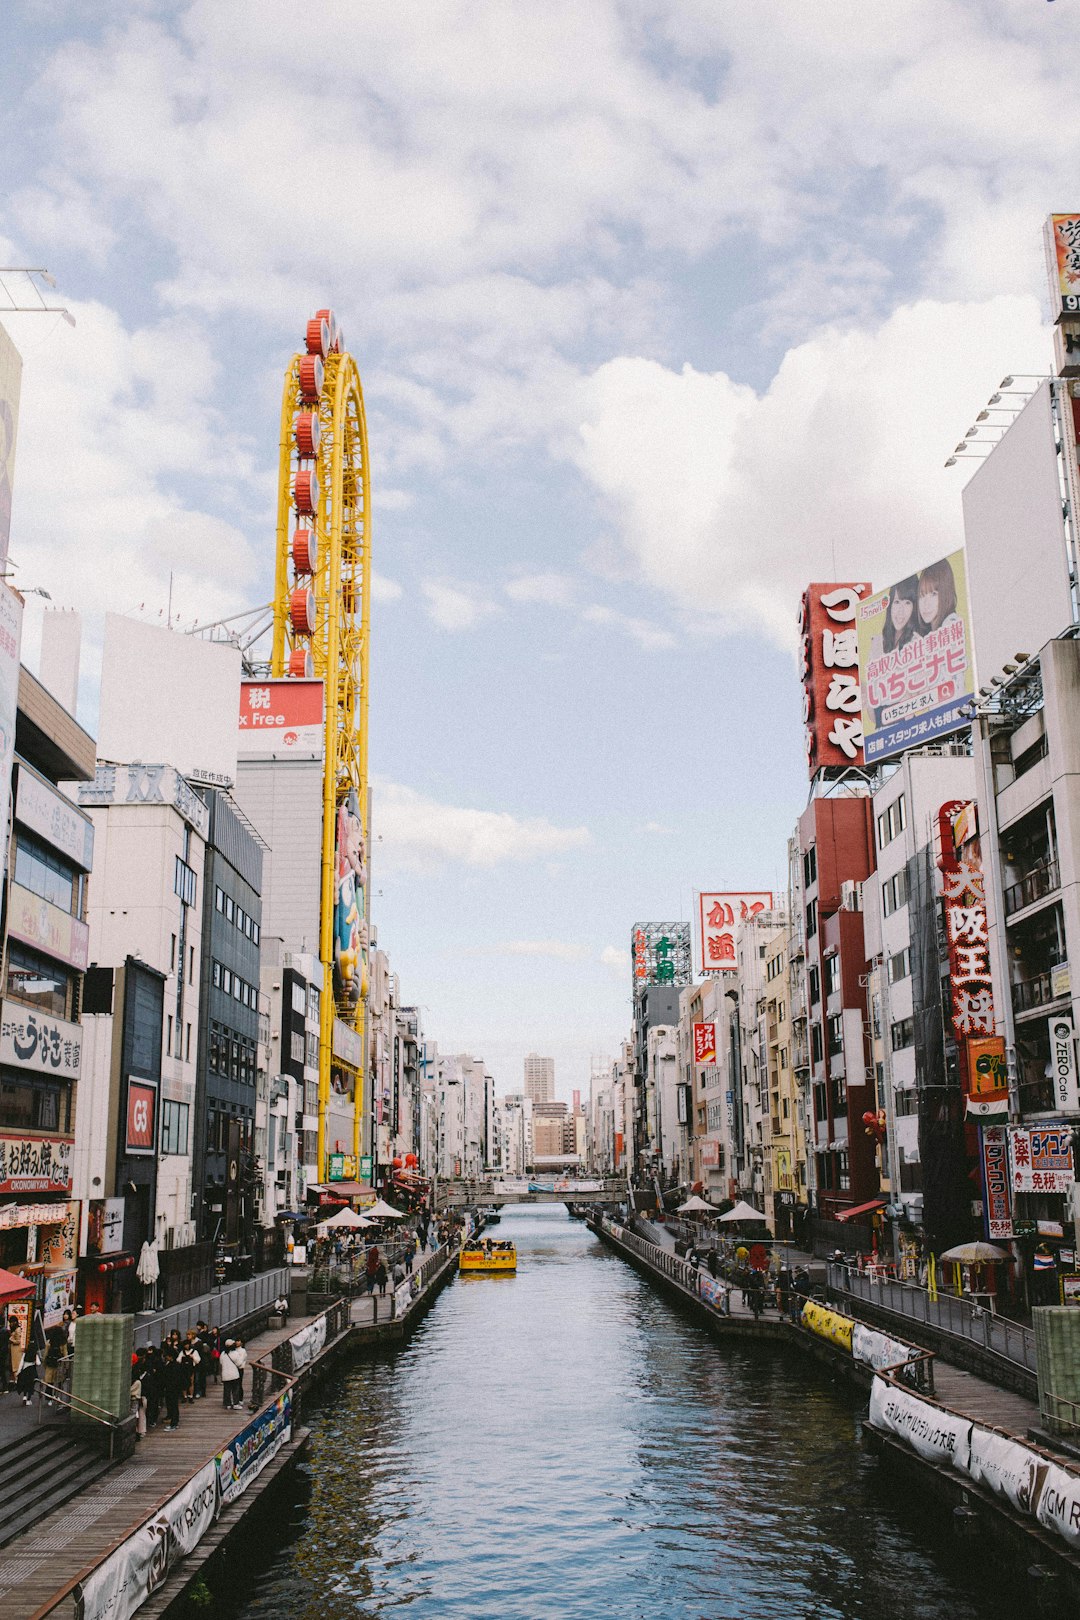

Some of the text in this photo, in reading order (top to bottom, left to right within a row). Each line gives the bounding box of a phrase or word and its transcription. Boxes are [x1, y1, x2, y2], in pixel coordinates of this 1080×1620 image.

[867, 620, 962, 680] 高収入お仕事情報
[820, 583, 867, 758] づぼらや
[868, 640, 966, 706] いちごナビ
[248, 687, 271, 709] 税
[884, 693, 934, 721] いちごナビ 求人
[252, 712, 286, 726] Free
[192, 768, 232, 783] 意匠作成中
[655, 936, 675, 980] 千房
[940, 862, 994, 1033] 大阪王将
[14, 1015, 64, 1068] うなぎ
[696, 1029, 705, 1057] ドラッグ
[704, 1025, 714, 1050] ツルハ
[1056, 1041, 1069, 1076] ZERO
[133, 1099, 148, 1132] G3
[9, 1141, 52, 1177] お好み焼
[1032, 1134, 1070, 1157] ダイコク
[11, 1180, 49, 1190] OKONOMIYAKI
[988, 1147, 1005, 1193] ダイコク
[1032, 1172, 1057, 1190] 免税
[990, 1221, 1011, 1231] 免税
